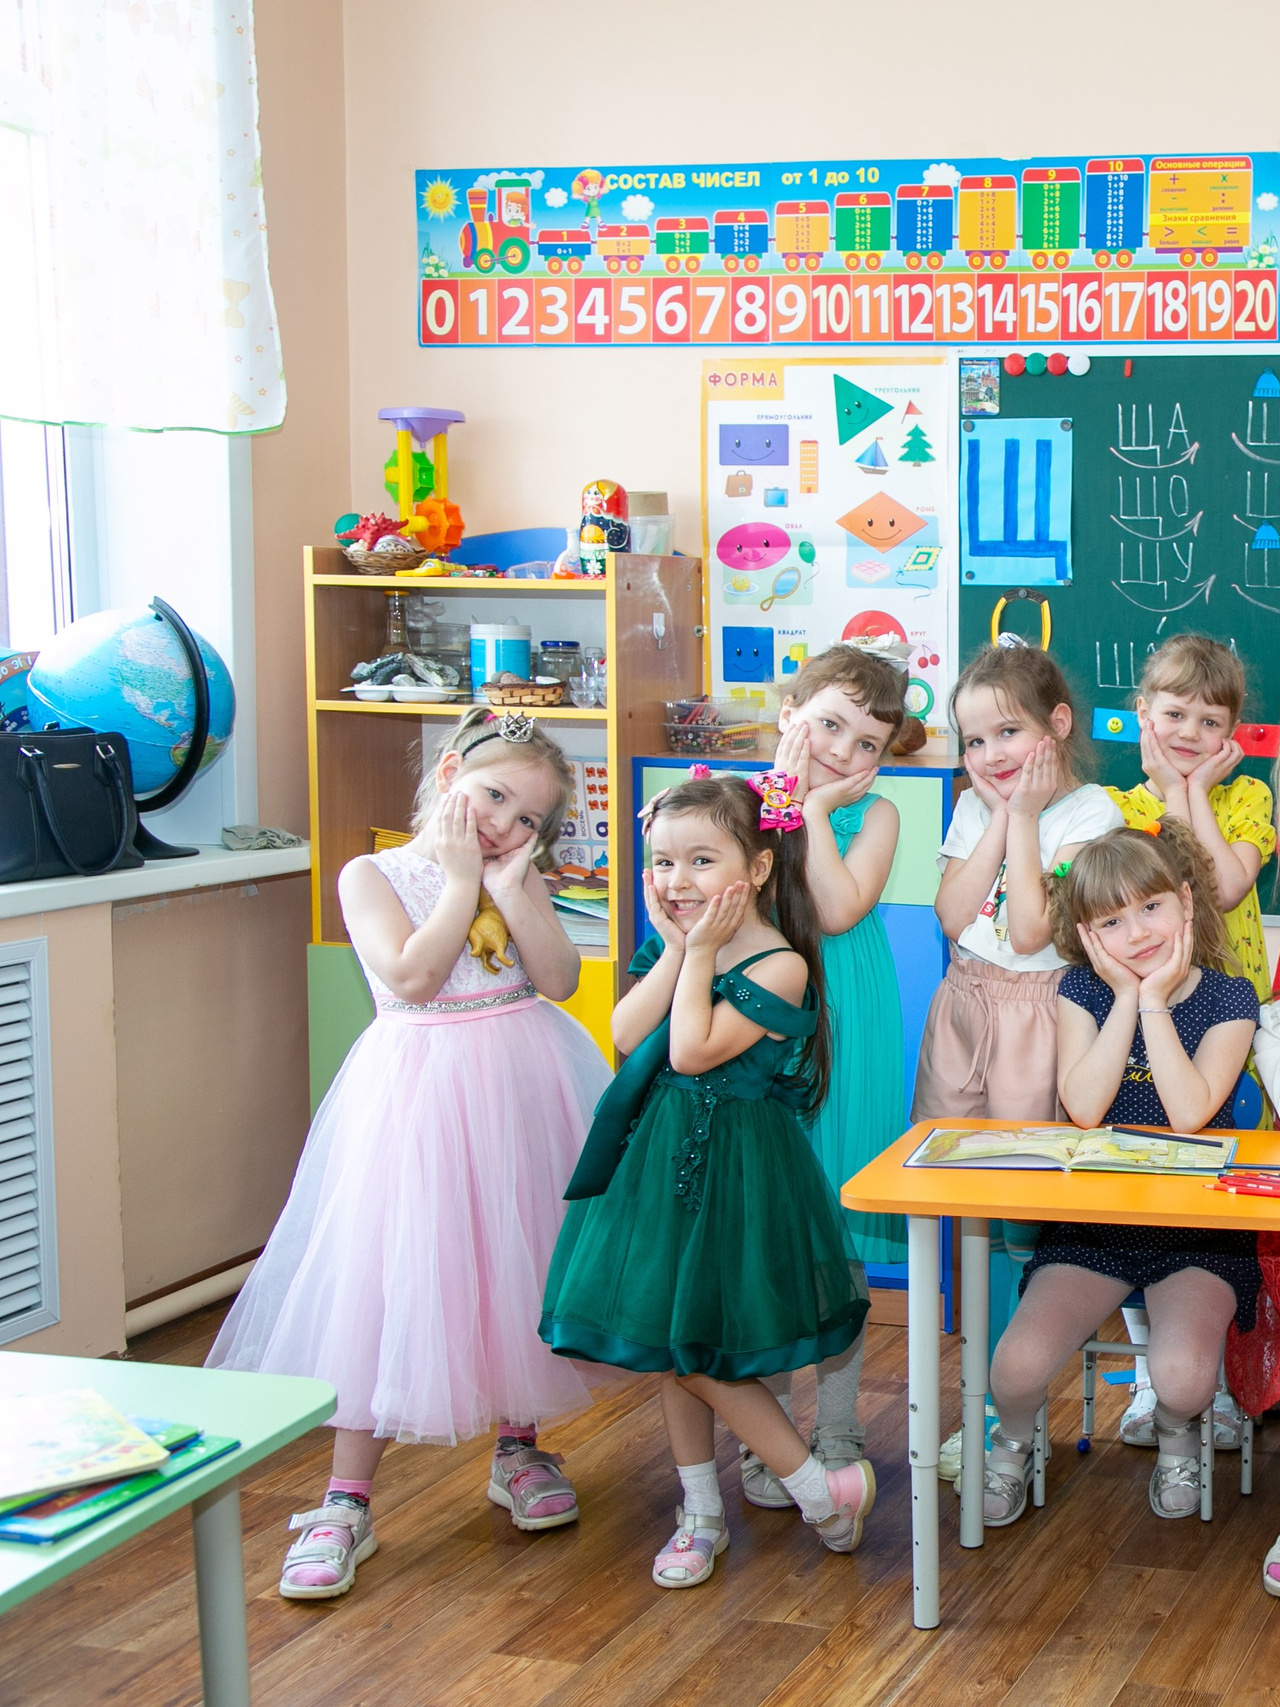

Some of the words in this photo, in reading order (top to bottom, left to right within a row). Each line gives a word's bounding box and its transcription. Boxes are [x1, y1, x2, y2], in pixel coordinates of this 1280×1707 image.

[1107, 160, 1124, 172] 10
[1155, 160, 1201, 170] Основные
[1202, 160, 1247, 170] операции
[604, 172, 686, 190] СОСТАВ
[690, 171, 761, 188] ЧИСЕЛ
[781, 172, 806, 185] от
[809, 169, 819, 183] 1
[825, 170, 850, 187] до
[856, 167, 880, 184] 10
[1047, 169, 1057, 180] 9
[983, 177, 993, 188] 8
[920, 186, 930, 197] 7
[858, 194, 868, 205] 6
[798, 202, 807, 213] 5
[737, 212, 746, 223] 4
[1162, 214, 1188, 222] Знаки
[1189, 214, 1237, 223] сравнения
[677, 218, 687, 229] 3
[619, 225, 628, 236] 2
[561, 231, 568, 242] 1
[427, 290, 454, 334] 0
[469, 289, 487, 335] 1
[502, 287, 530, 335] 2
[540, 286, 569, 335] 3
[577, 288, 609, 335] 4
[618, 286, 647, 335] 5
[656, 286, 687, 334] 6
[696, 287, 725, 334] 7
[735, 285, 766, 334] 8
[775, 284, 806, 333] 9
[814, 284, 849, 333] 10
[854, 285, 888, 333] 11
[895, 284, 932, 333] 12
[936, 283, 974, 333] 13
[978, 284, 1016, 332] 14
[1021, 283, 1059, 332] 15
[1063, 282, 1100, 332] 16
[1105, 282, 1144, 331] 17
[1148, 280, 1187, 331] 18
[1191, 280, 1231, 331] 19
[1236, 280, 1275, 331] 20
[708, 372, 778, 387] ФОРМА
[1118, 402, 1190, 465] ЩА
[967, 438, 1068, 581] Щ
[1118, 475, 1190, 537] ЩО
[1119, 541, 1194, 602] ЩУ
